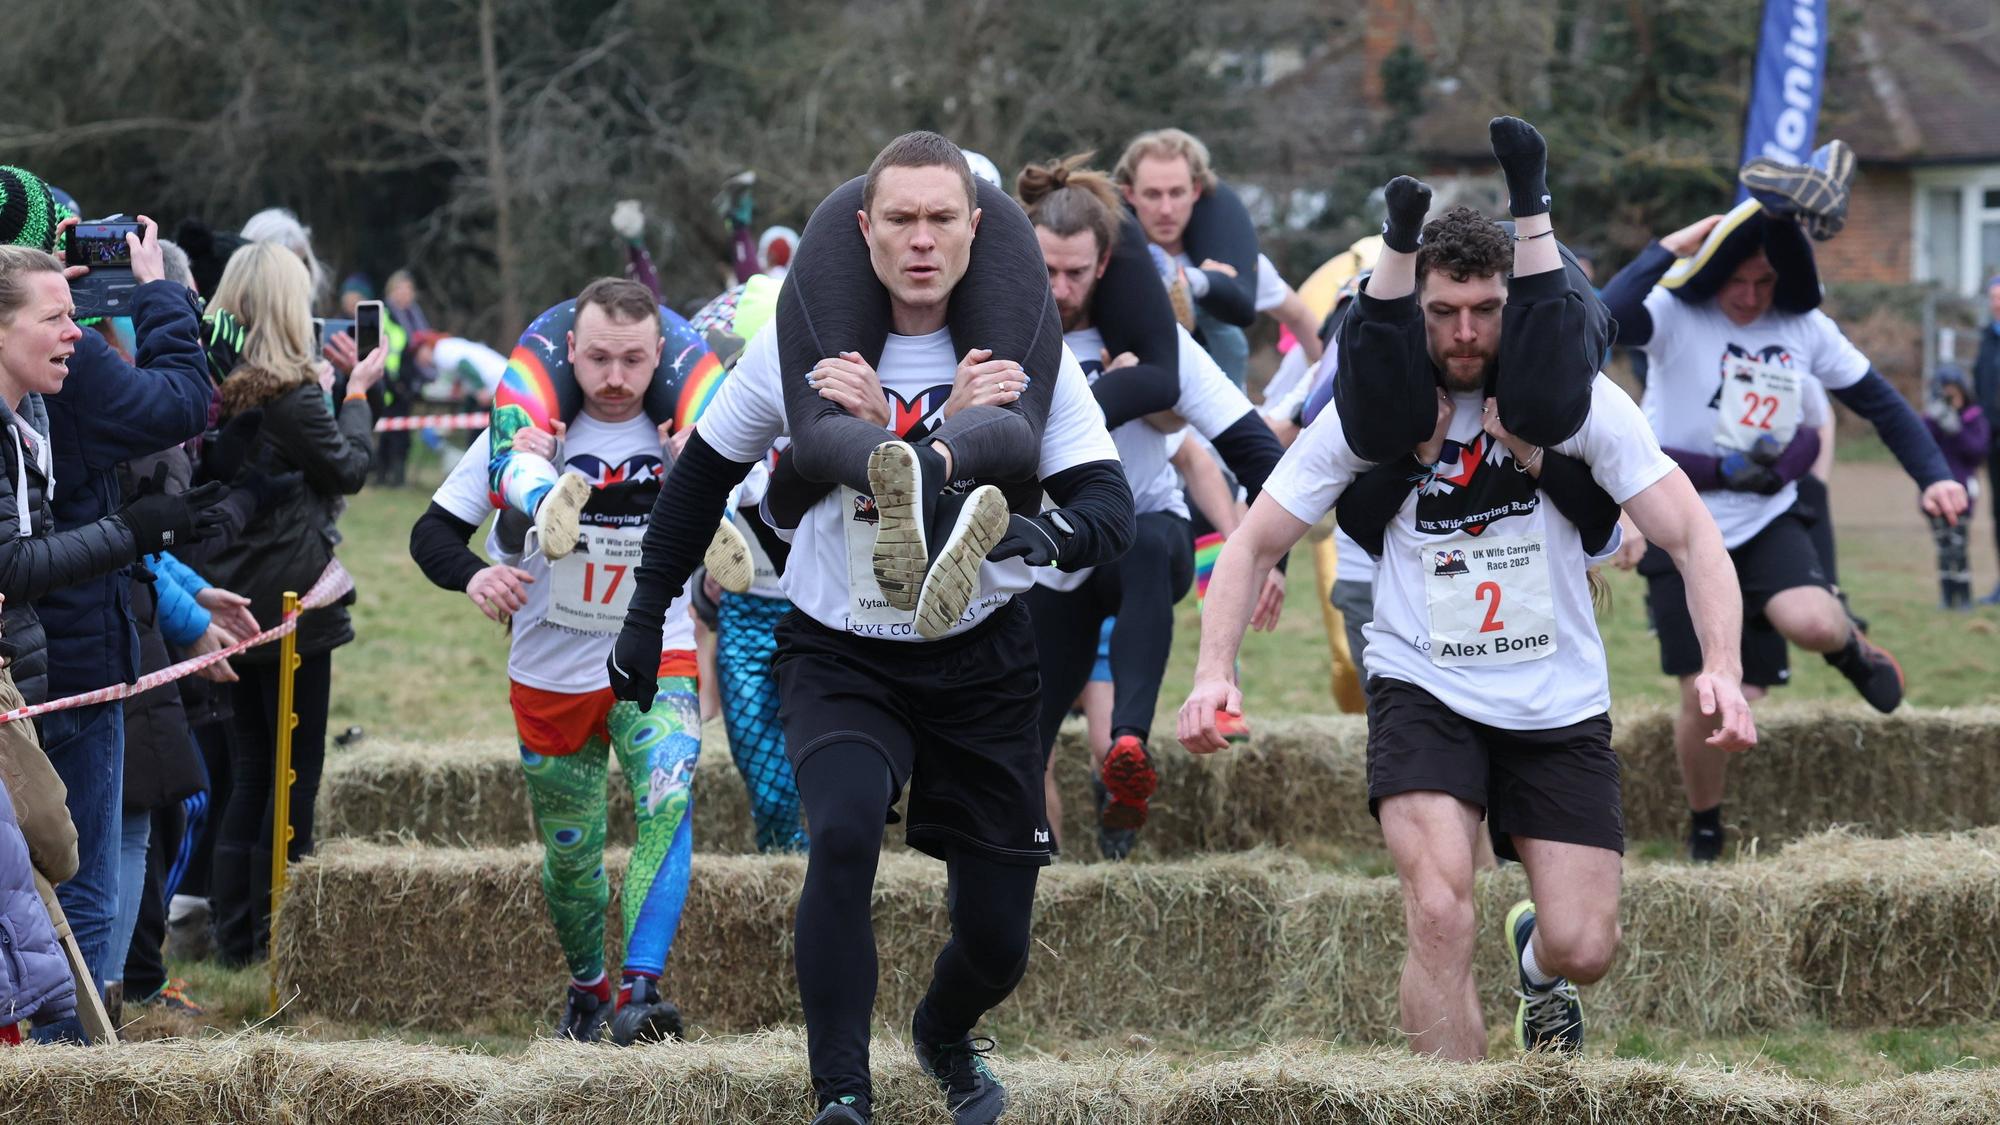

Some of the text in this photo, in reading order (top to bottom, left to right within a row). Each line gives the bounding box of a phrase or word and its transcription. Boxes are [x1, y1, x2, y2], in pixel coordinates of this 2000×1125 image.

[1738, 391, 1780, 430] 22
[594, 512, 641, 525] Carrying
[1419, 520, 1437, 530] UK
[595, 536, 605, 545] UK
[607, 537, 622, 547] Wife
[605, 548, 641, 557] Race 2023
[1472, 543, 1541, 559] UK Wife Carrying
[1487, 556, 1530, 571] Race 2023
[582, 562, 628, 605] 17
[555, 602, 594, 619] Sebastian
[858, 598, 893, 610] Vytau
[1474, 580, 1504, 634] 2
[1440, 632, 1550, 658] Alex Bone
